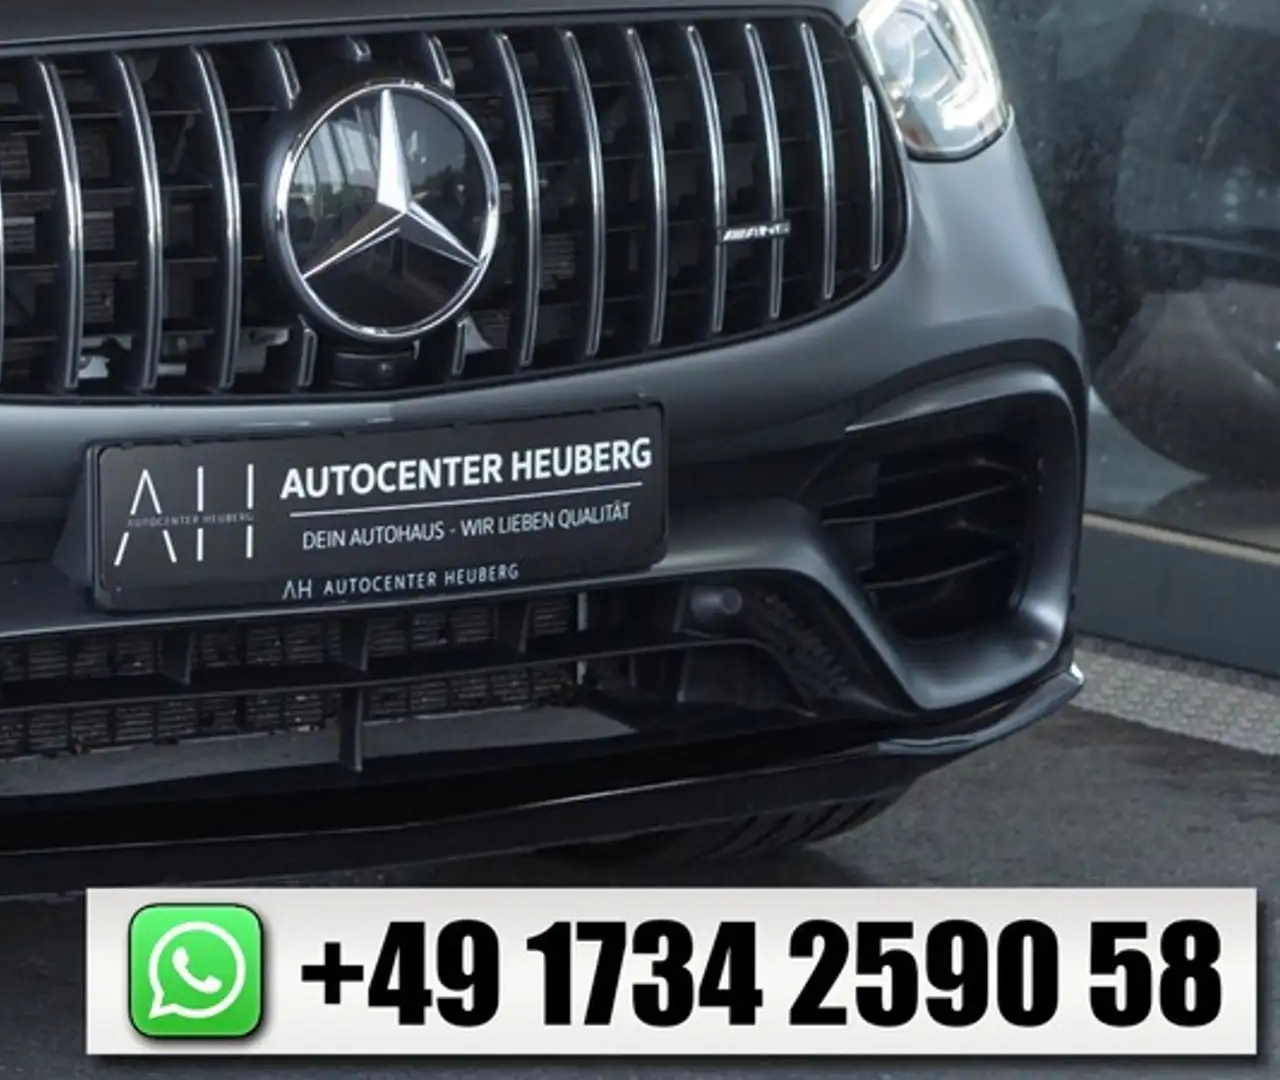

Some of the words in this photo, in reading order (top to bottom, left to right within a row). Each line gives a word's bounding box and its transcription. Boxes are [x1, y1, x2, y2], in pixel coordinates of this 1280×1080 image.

[280, 453, 503, 500] AUTOCENTER
[511, 436, 653, 483] HEUBERG
[113, 462, 255, 567] AH
[302, 526, 346, 551] DEIN
[349, 520, 445, 547] AUTOHAUS
[460, 514, 495, 538] WIR
[497, 509, 555, 536] LIEBEN
[557, 500, 631, 529] QUALITÄT
[322, 570, 438, 597] AUTOCENTER
[443, 562, 520, 588] HEUBERG
